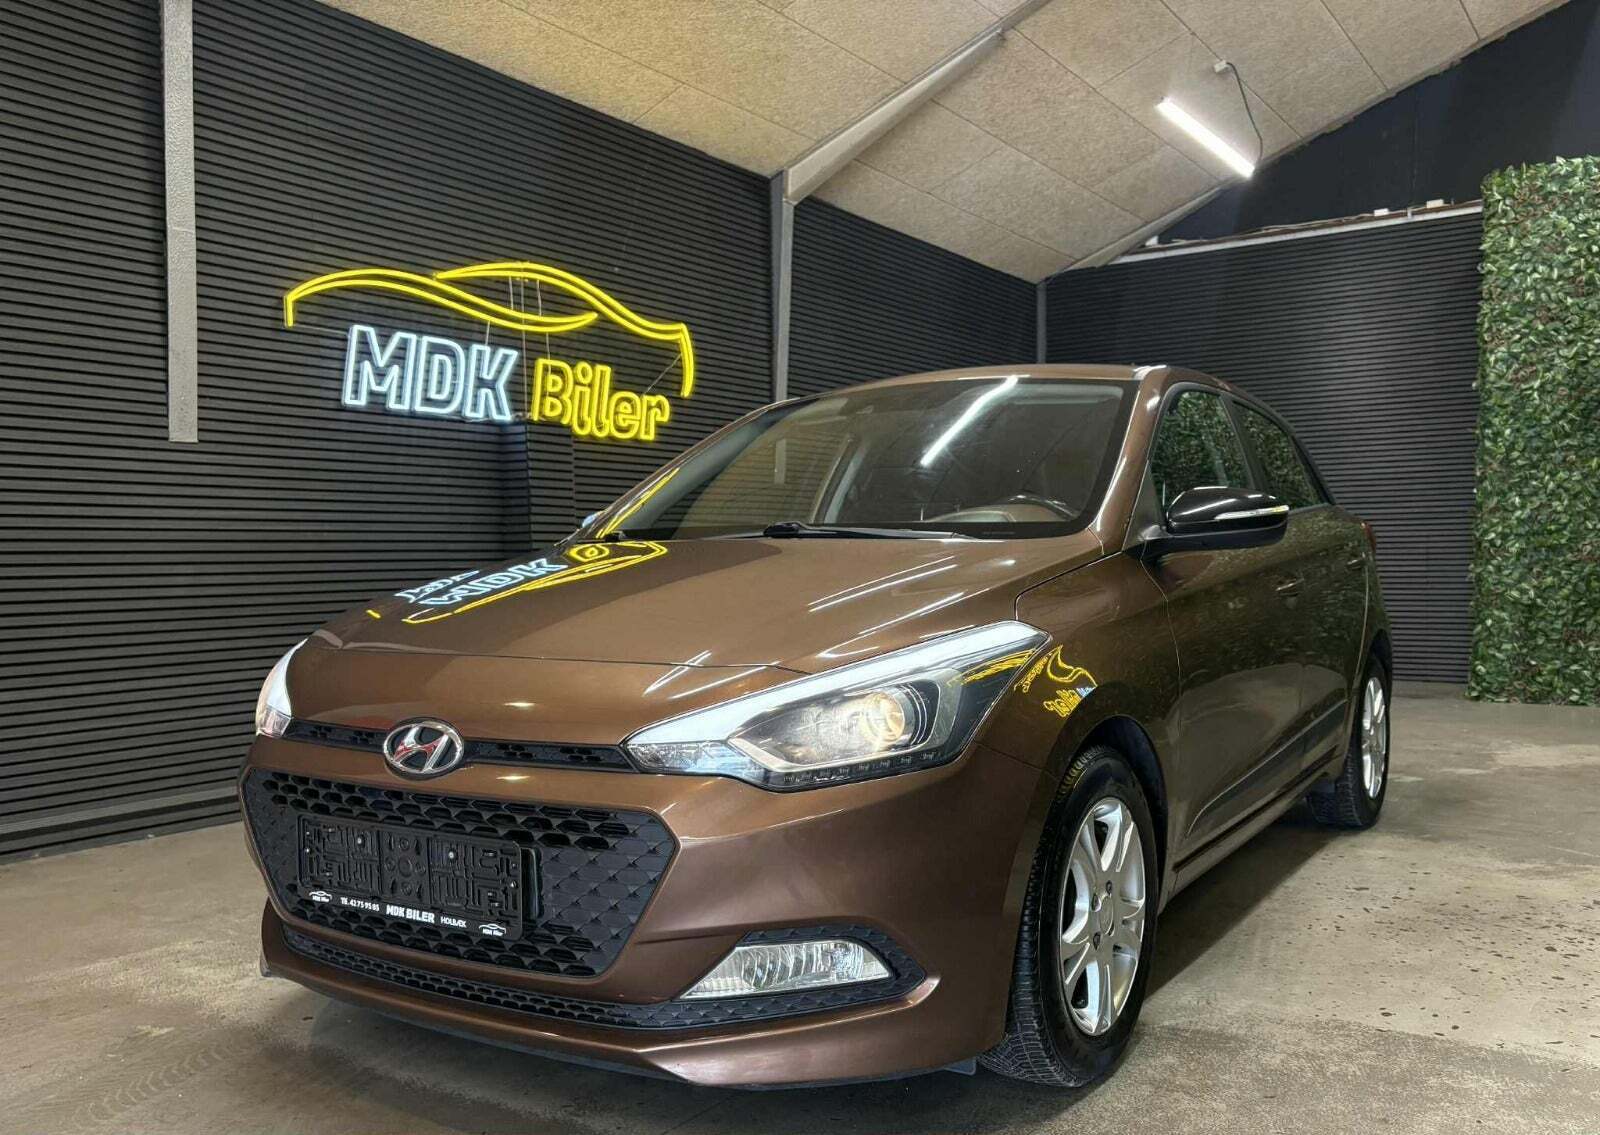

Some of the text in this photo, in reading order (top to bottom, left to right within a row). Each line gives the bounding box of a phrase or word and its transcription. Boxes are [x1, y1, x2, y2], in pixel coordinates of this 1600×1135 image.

[341, 324, 671, 441] MDK Biler
[386, 904, 405, 918] MDK
[406, 909, 435, 924] BILER
